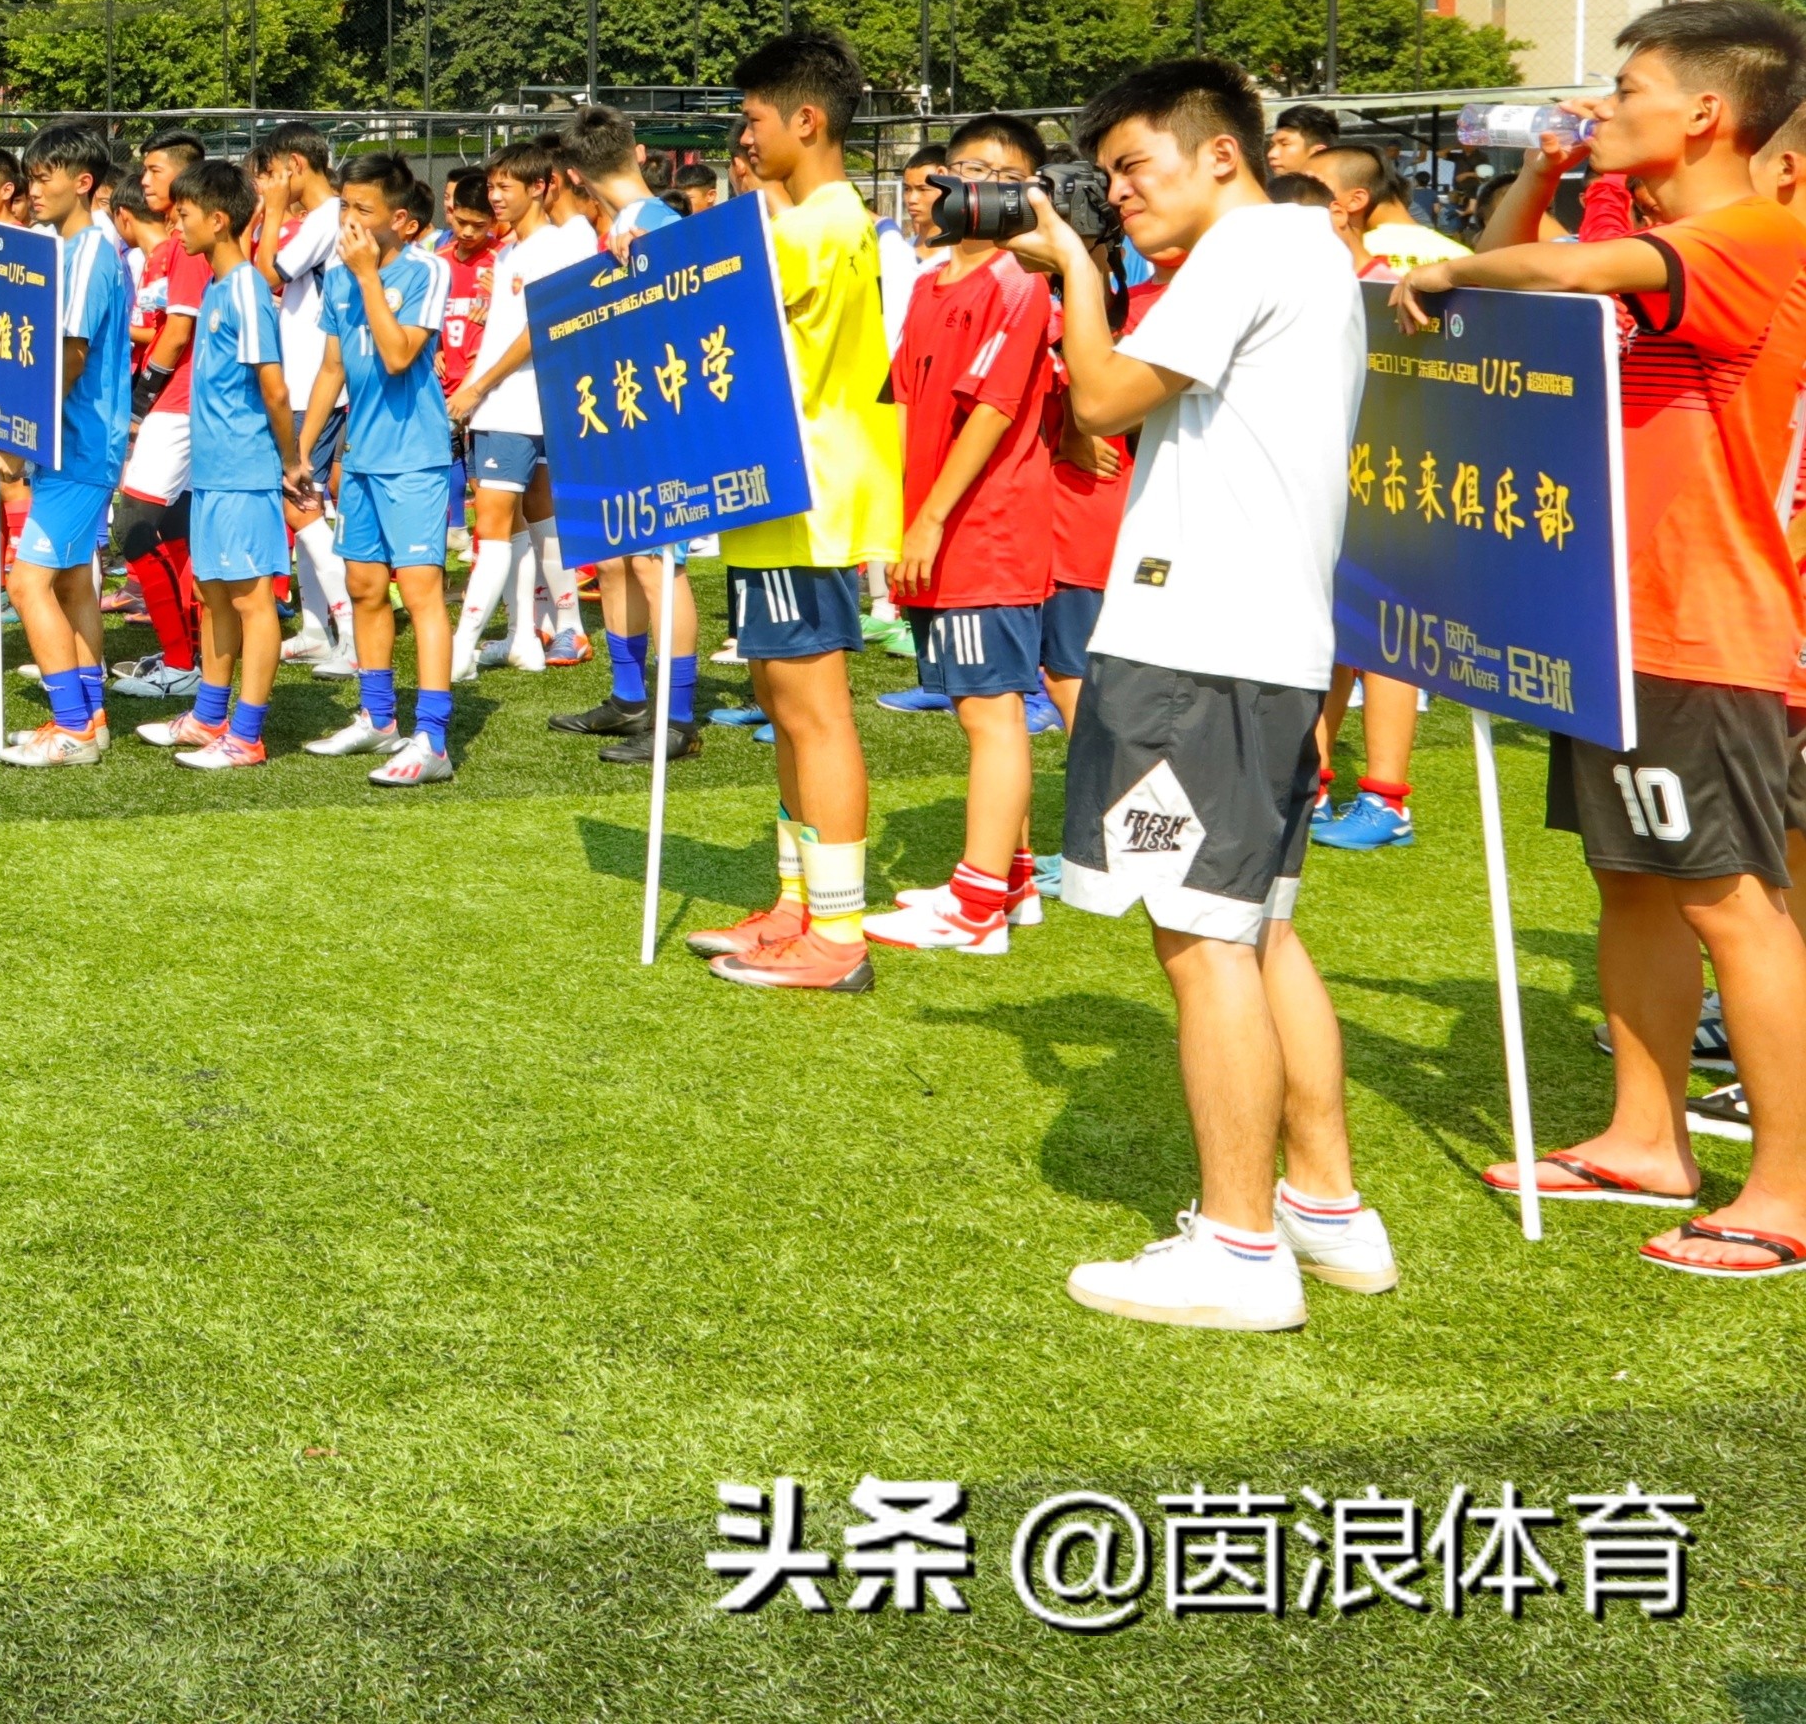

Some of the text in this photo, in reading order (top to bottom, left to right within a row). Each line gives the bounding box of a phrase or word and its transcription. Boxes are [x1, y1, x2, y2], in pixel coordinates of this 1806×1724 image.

[666, 265, 700, 301] U15
[576, 325, 735, 441] 天荣中学
[1482, 357, 1522, 398] U15
[1526, 371, 1574, 397] 超级联赛
[12, 416, 38, 451] 足球
[602, 485, 657, 546] U15
[713, 464, 771, 515] 足球
[1348, 443, 1574, 552] 好未来俱乐部
[1379, 599, 1441, 677] U15
[1507, 645, 1575, 715] 足球
[1613, 764, 1691, 842] 10
